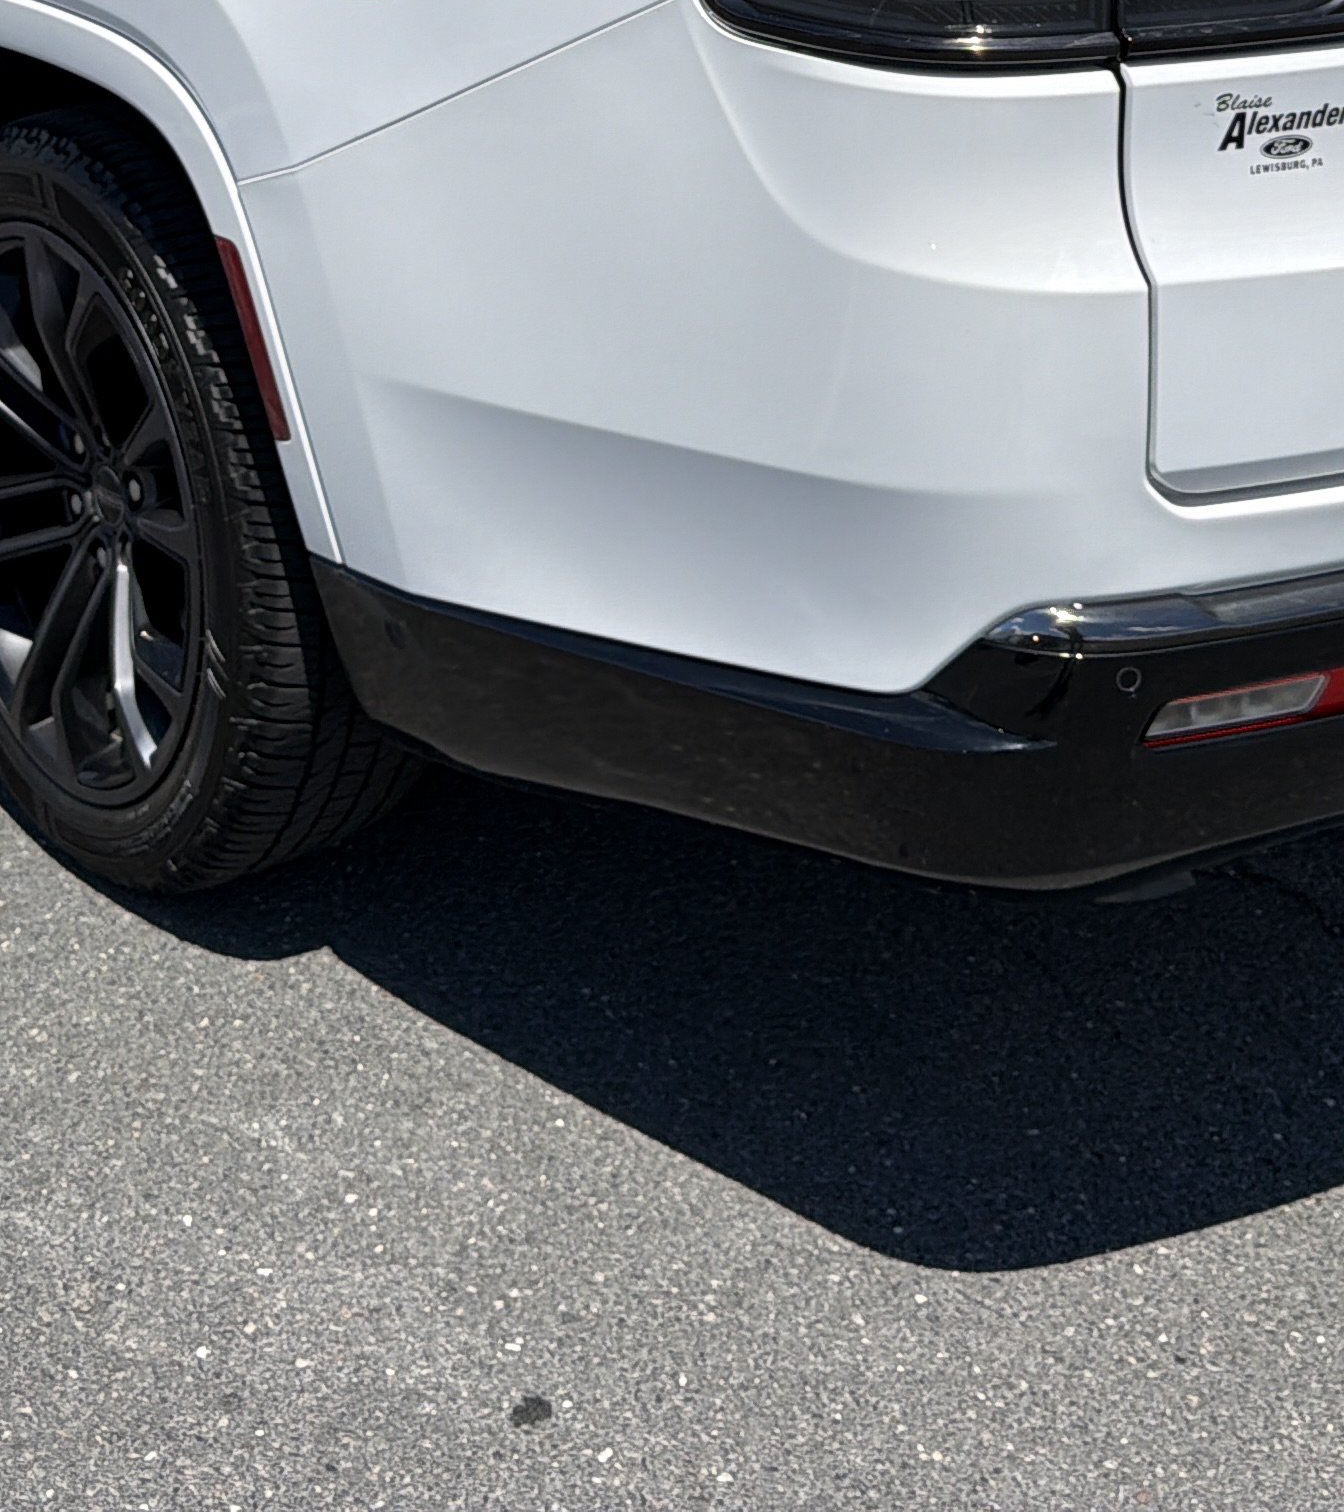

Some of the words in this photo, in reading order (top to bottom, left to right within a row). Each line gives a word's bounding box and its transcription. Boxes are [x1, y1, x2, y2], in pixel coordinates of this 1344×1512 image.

[1216, 93, 1272, 113] Blaise
[1250, 159, 1310, 175] LEWISBURG,
[1312, 158, 1324, 168] PA
